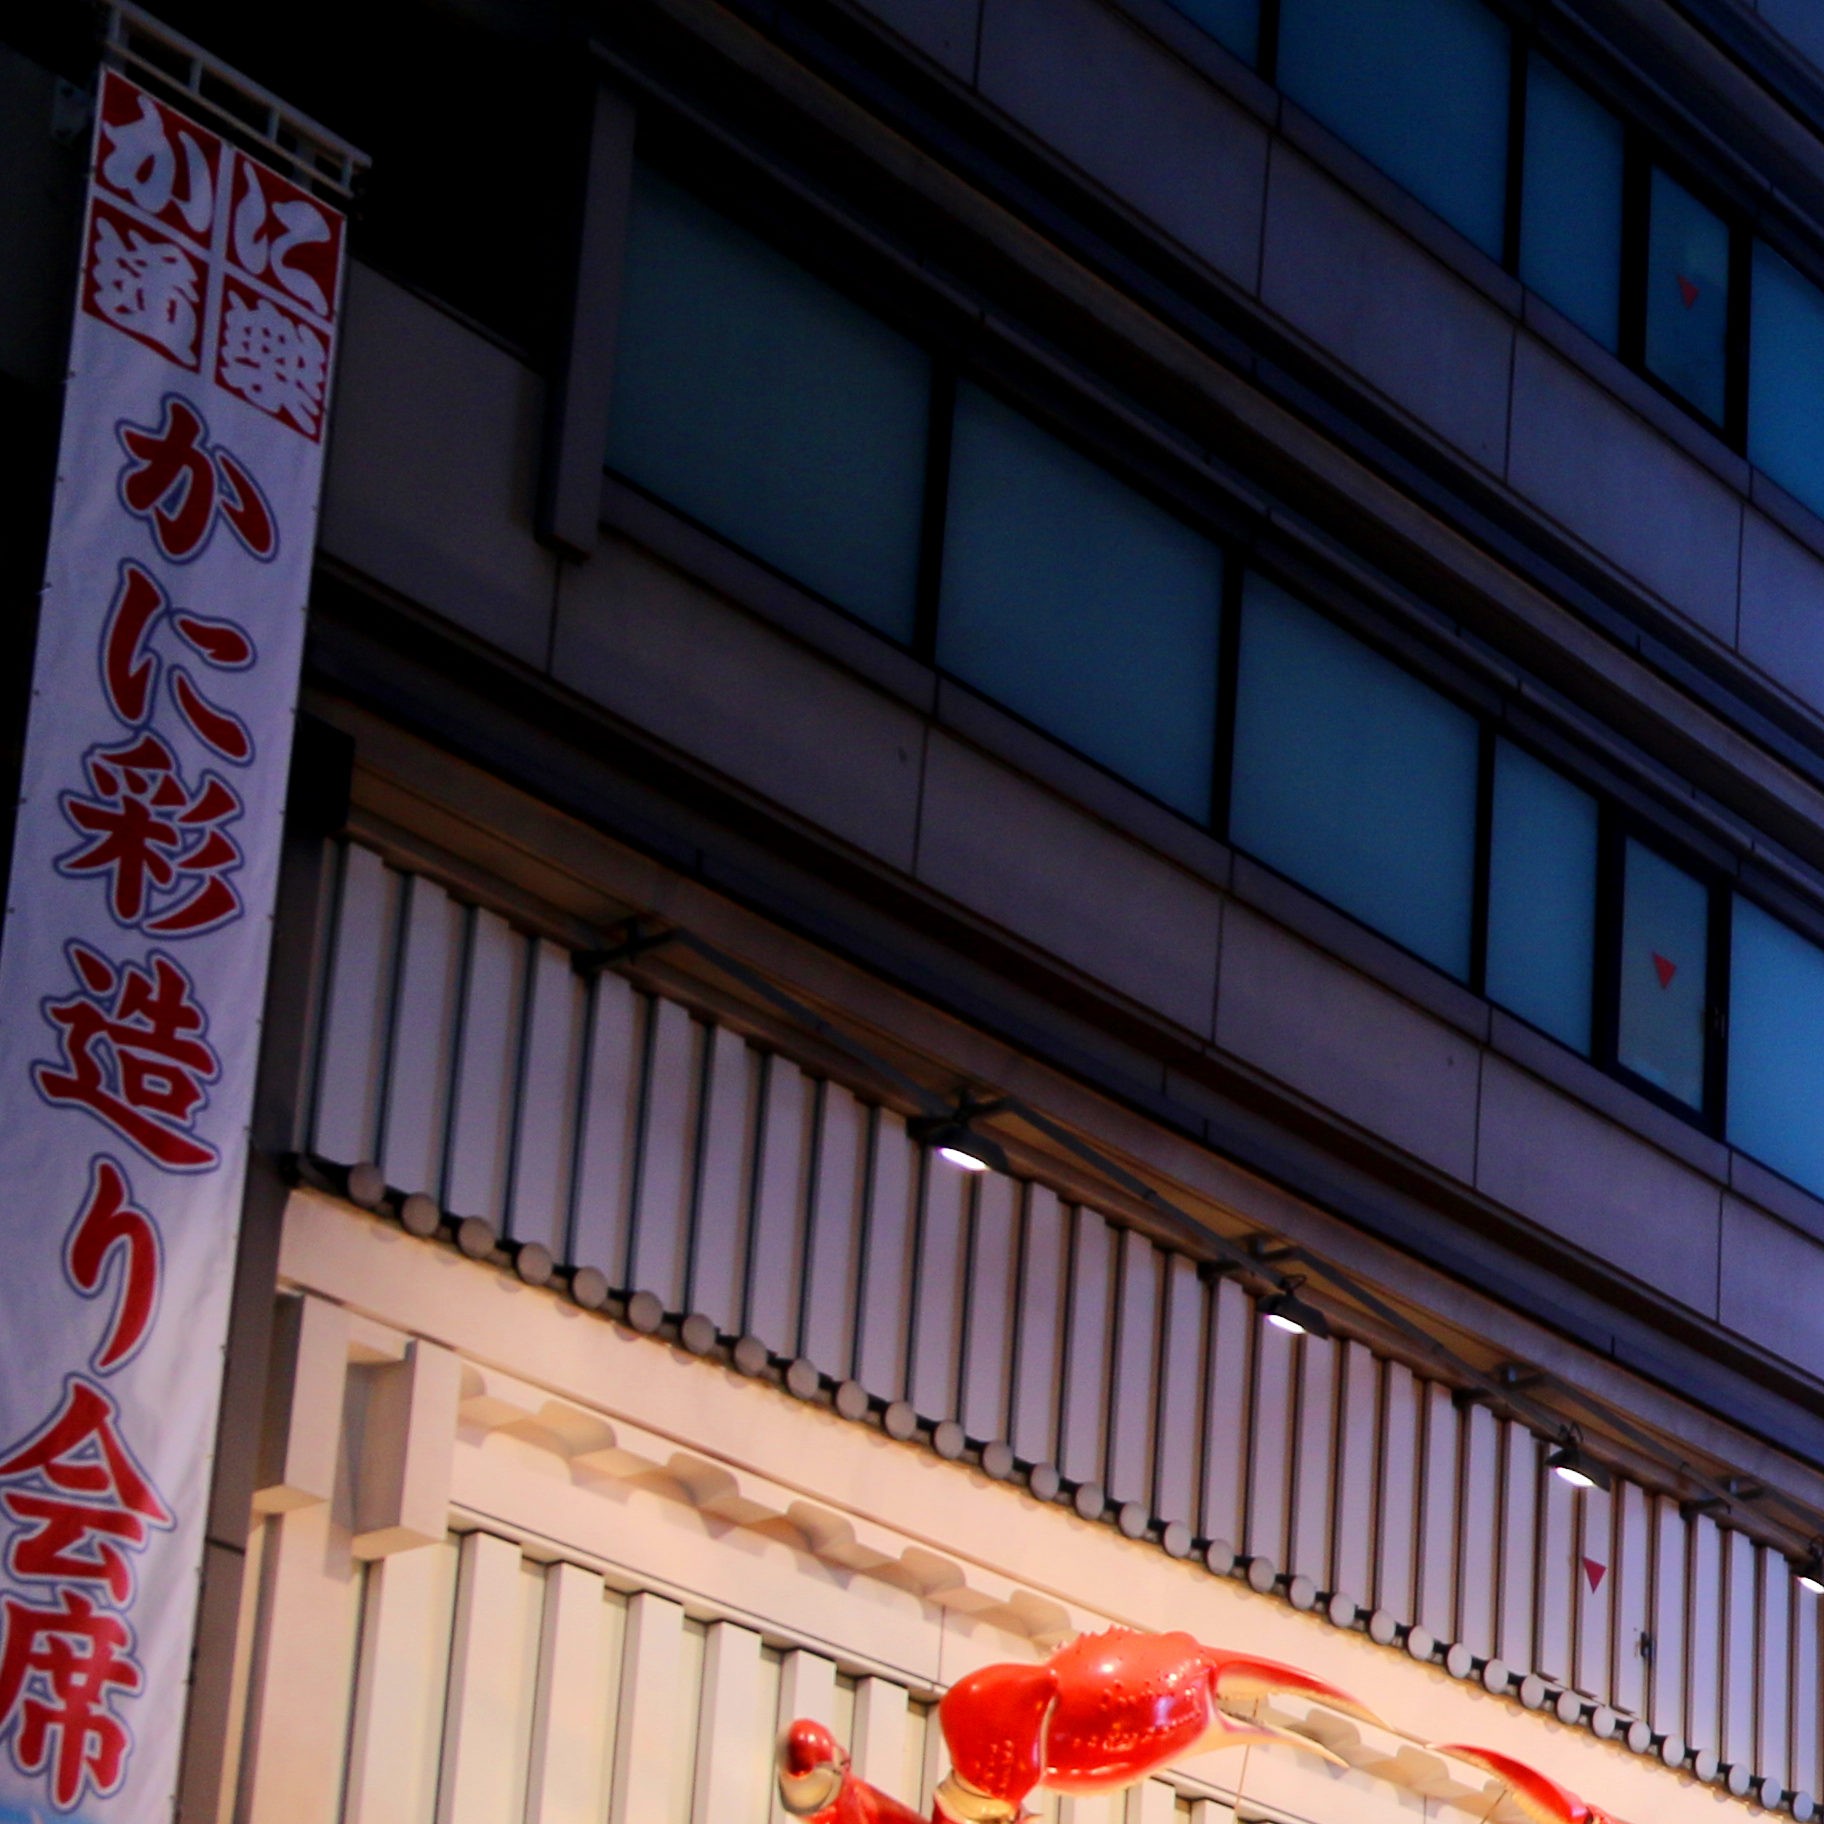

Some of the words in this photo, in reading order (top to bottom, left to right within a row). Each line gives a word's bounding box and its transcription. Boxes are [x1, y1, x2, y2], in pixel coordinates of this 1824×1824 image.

[0, 394, 280, 1811] かに彩造り会席
